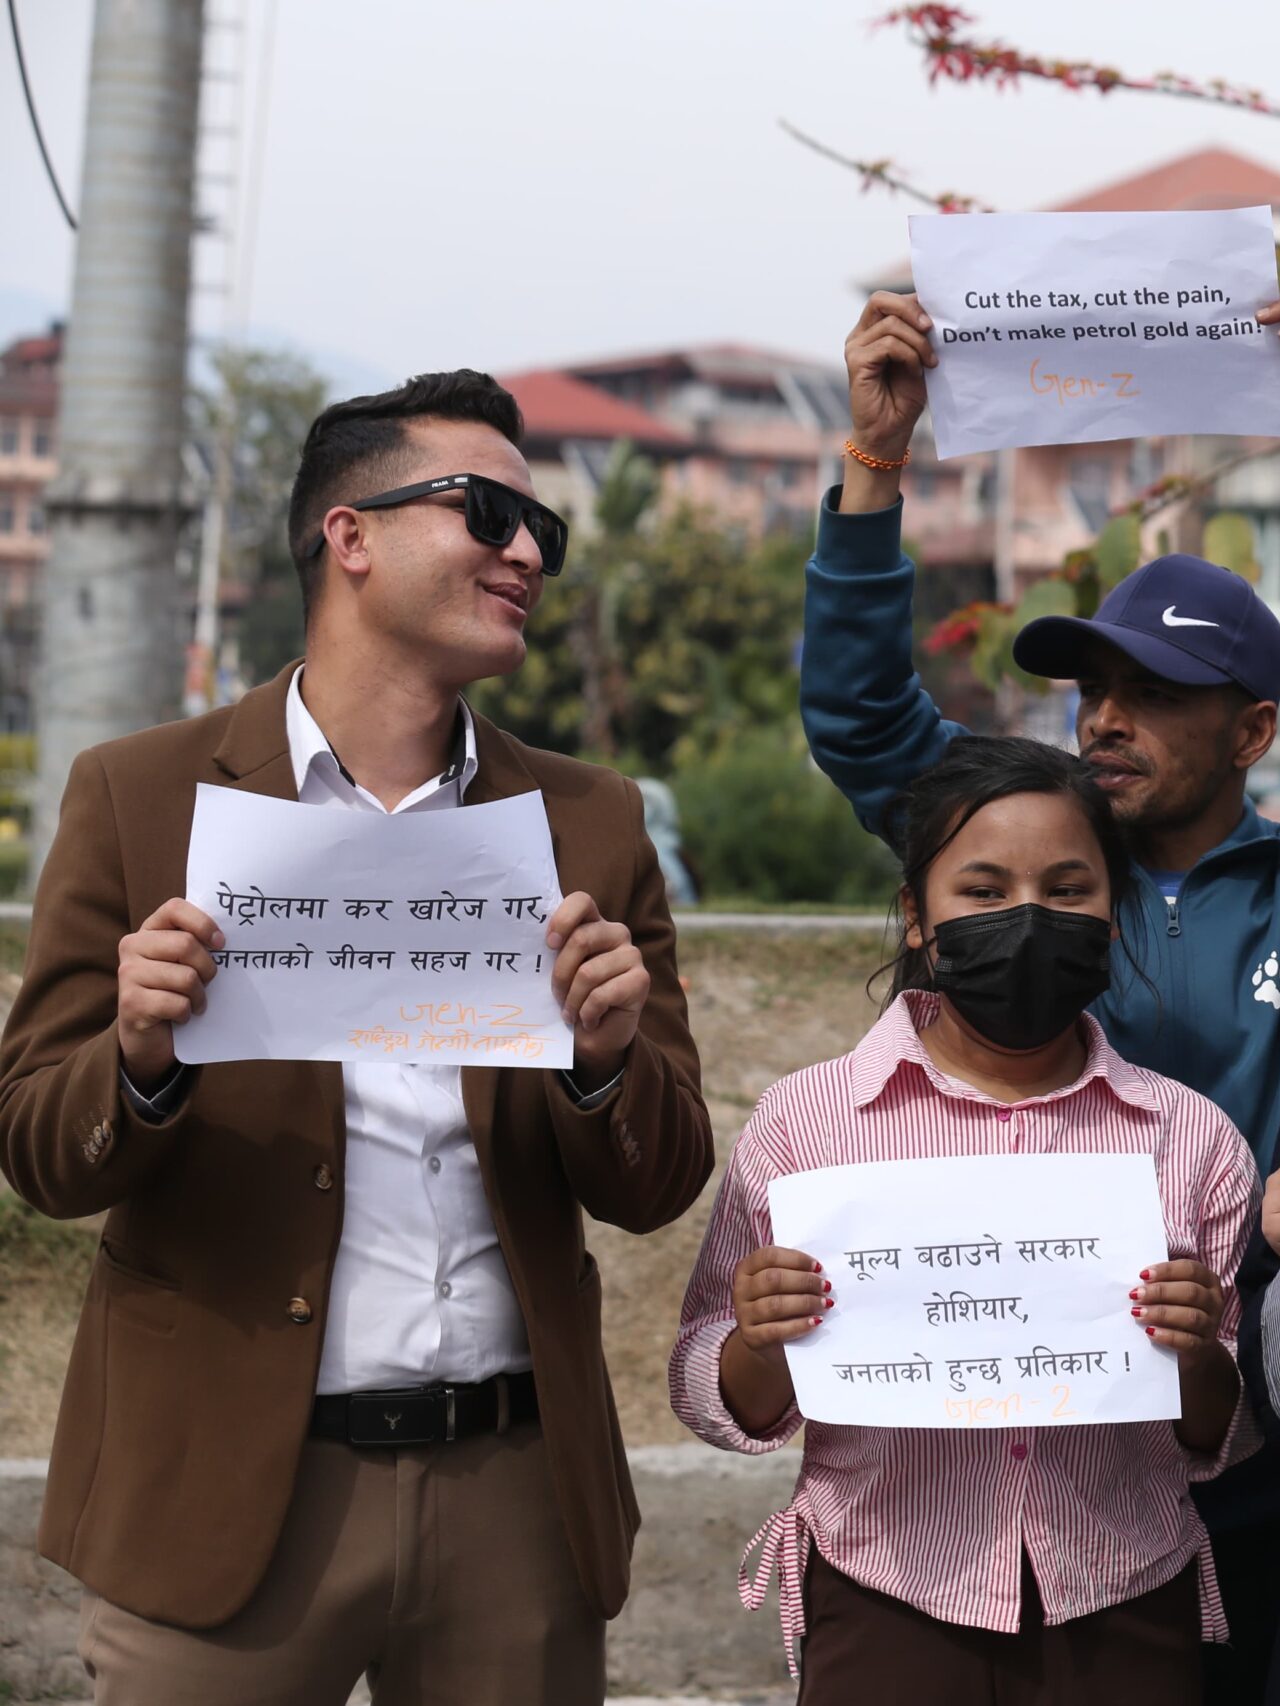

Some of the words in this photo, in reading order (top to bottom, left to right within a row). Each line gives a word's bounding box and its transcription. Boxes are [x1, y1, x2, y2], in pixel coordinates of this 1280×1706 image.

[964, 291, 1001, 309] Cut
[1005, 289, 1042, 309] the
[1047, 291, 1088, 311] tax,
[1094, 289, 1129, 307] cut
[1132, 286, 1170, 306] the
[1176, 284, 1231, 309] pain,
[1007, 324, 1067, 341] make
[1072, 321, 1137, 342] petrol
[1143, 320, 1189, 341] gold
[1195, 317, 1262, 341] again!
[216, 881, 330, 927] पेट्रोलमा
[342, 899, 394, 921] कर
[406, 889, 489, 922] खारेज
[501, 895, 548, 924] गर,
[211, 943, 314, 971] जनताको
[325, 943, 397, 970] जीवन
[407, 950, 472, 974] सहज
[482, 951, 522, 973] गर
[535, 953, 543, 974] !
[843, 1247, 902, 1281] मूल्य
[913, 1233, 1003, 1268] बढाउने
[1014, 1237, 1101, 1264] सरकार
[922, 1290, 1029, 1327] होशियार,
[831, 1352, 934, 1384] जनताको
[944, 1357, 1003, 1393] हुन्छ
[1013, 1345, 1109, 1379] प्रतिकार
[1124, 1351, 1131, 1373] !
